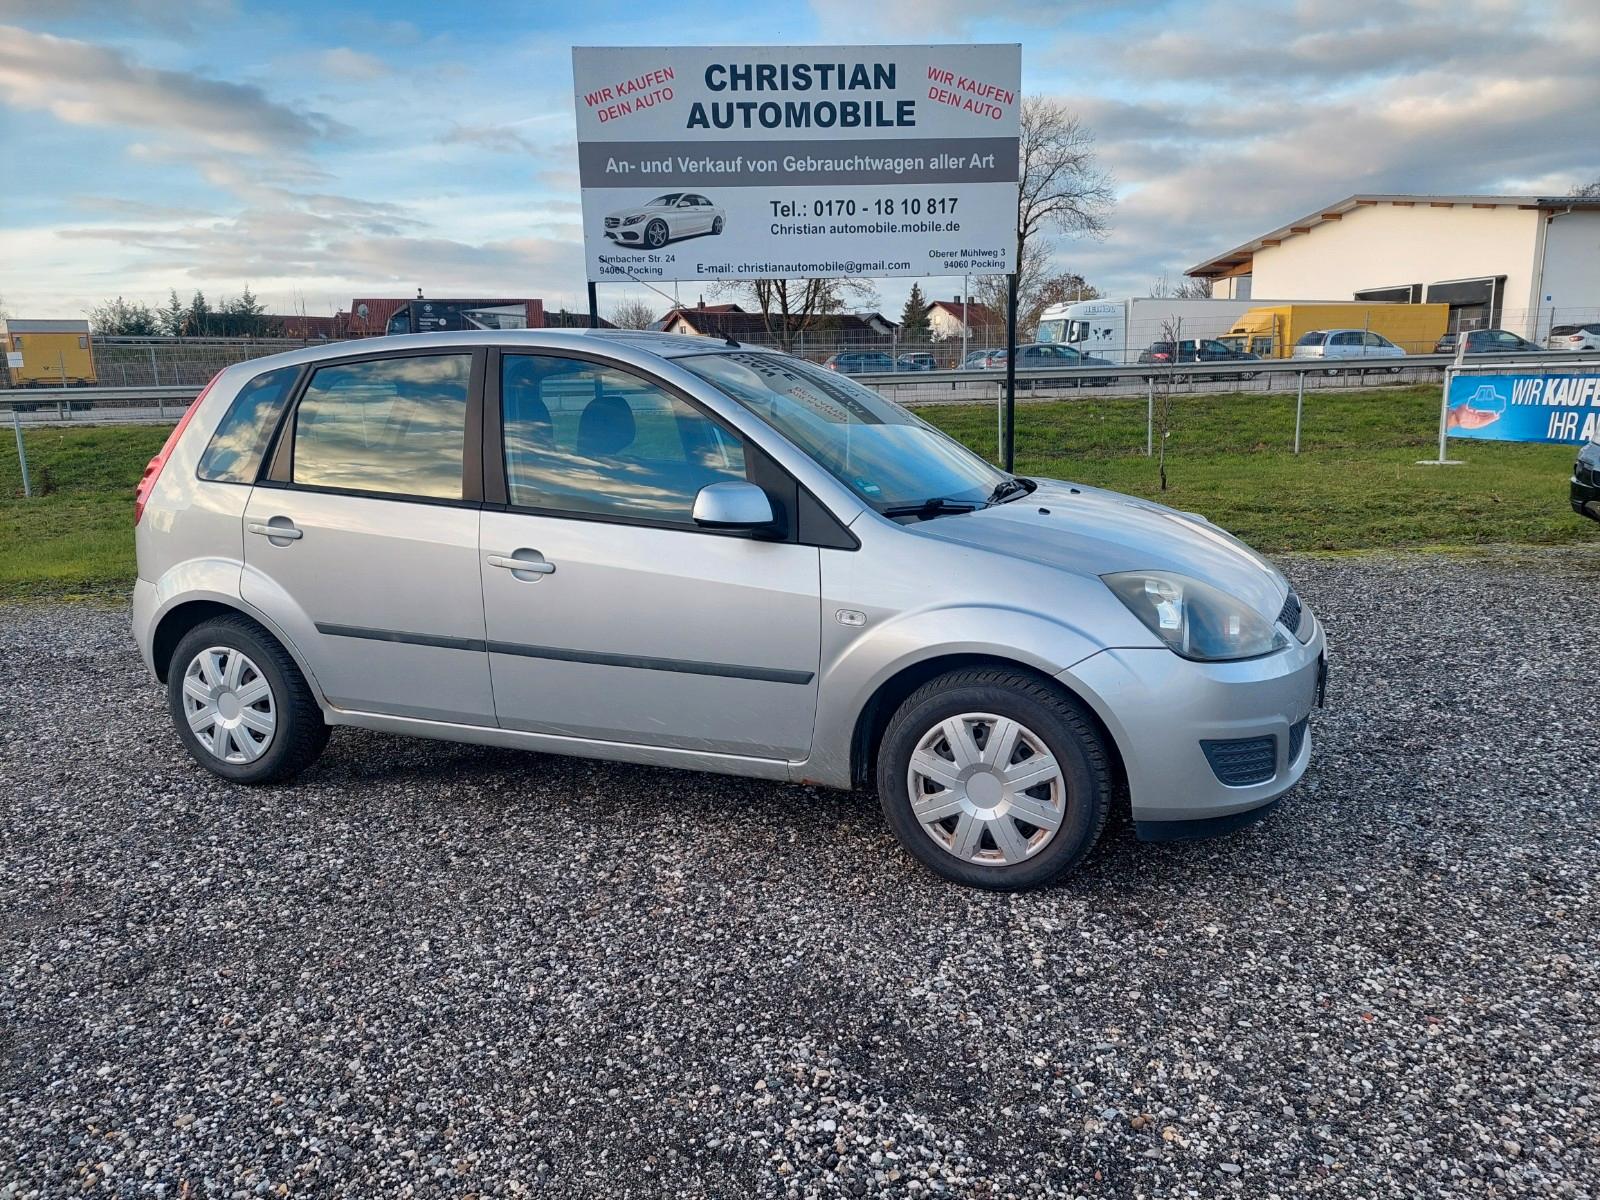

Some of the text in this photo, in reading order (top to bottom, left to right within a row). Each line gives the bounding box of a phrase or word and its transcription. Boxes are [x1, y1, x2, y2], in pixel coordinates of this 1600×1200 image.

[584, 66, 675, 107] WIR KAUFEN
[704, 63, 896, 92] CHRISTIAN
[927, 66, 1014, 105] WIR KAUFEN
[597, 87, 673, 123] DEIN AUTO
[686, 101, 916, 129] AUTOMOBILE
[928, 86, 1002, 120] DEIN AUTO
[605, 153, 995, 174] An- und Verkauf von Gebrauchtwagen aller Art
[770, 200, 807, 217] Tel.:
[813, 199, 856, 216] 0170
[874, 199, 894, 215] 18
[901, 198, 921, 215] 10
[927, 198, 958, 214] 817
[770, 221, 961, 235] Christian automobile.mobile.de
[599, 254, 676, 263] Simbacher Str. 24
[928, 248, 1006, 259] Oberer Mühlweg 3
[943, 260, 1006, 269] 94060 Pocking
[599, 266, 663, 276] 94060 Pocking
[696, 261, 911, 274] E-mail: christianautomobile@gmail.com
[1511, 378, 1544, 406] WIR
[1547, 411, 1579, 440] IHR
